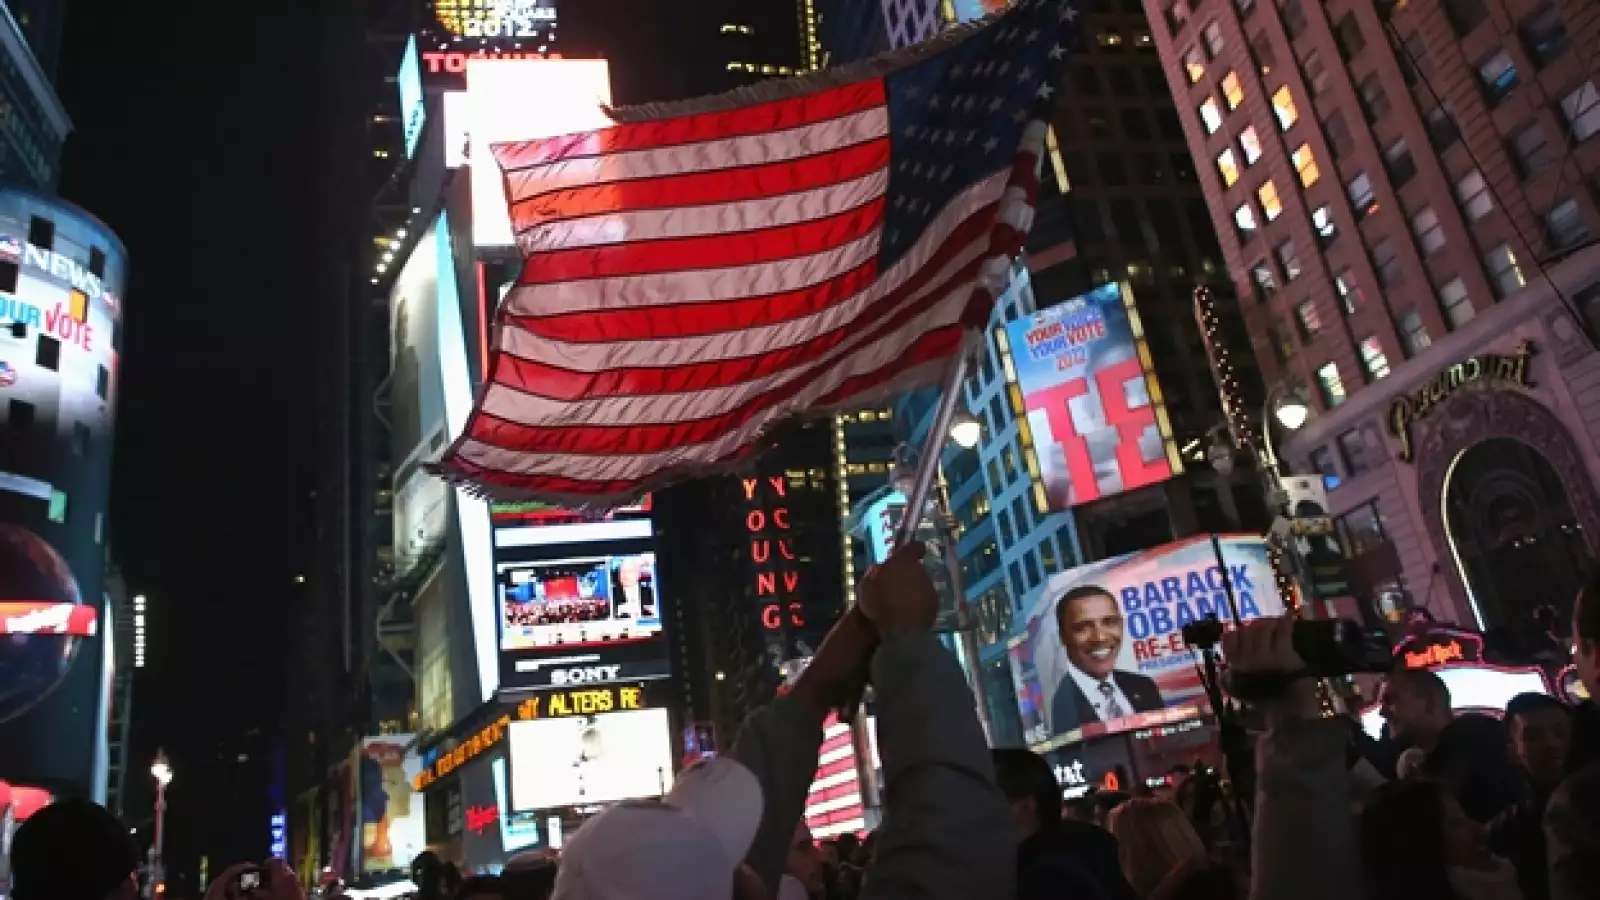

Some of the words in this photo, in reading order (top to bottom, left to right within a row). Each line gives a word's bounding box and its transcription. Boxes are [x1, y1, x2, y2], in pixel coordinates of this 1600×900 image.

[45, 301, 93, 352] VOTE
[742, 478, 781, 629] YOUNG
[1120, 563, 1254, 612] BARACK
[1127, 591, 1261, 640] OBAMA
[550, 664, 621, 684] SONY
[549, 689, 614, 716] ALTERS
